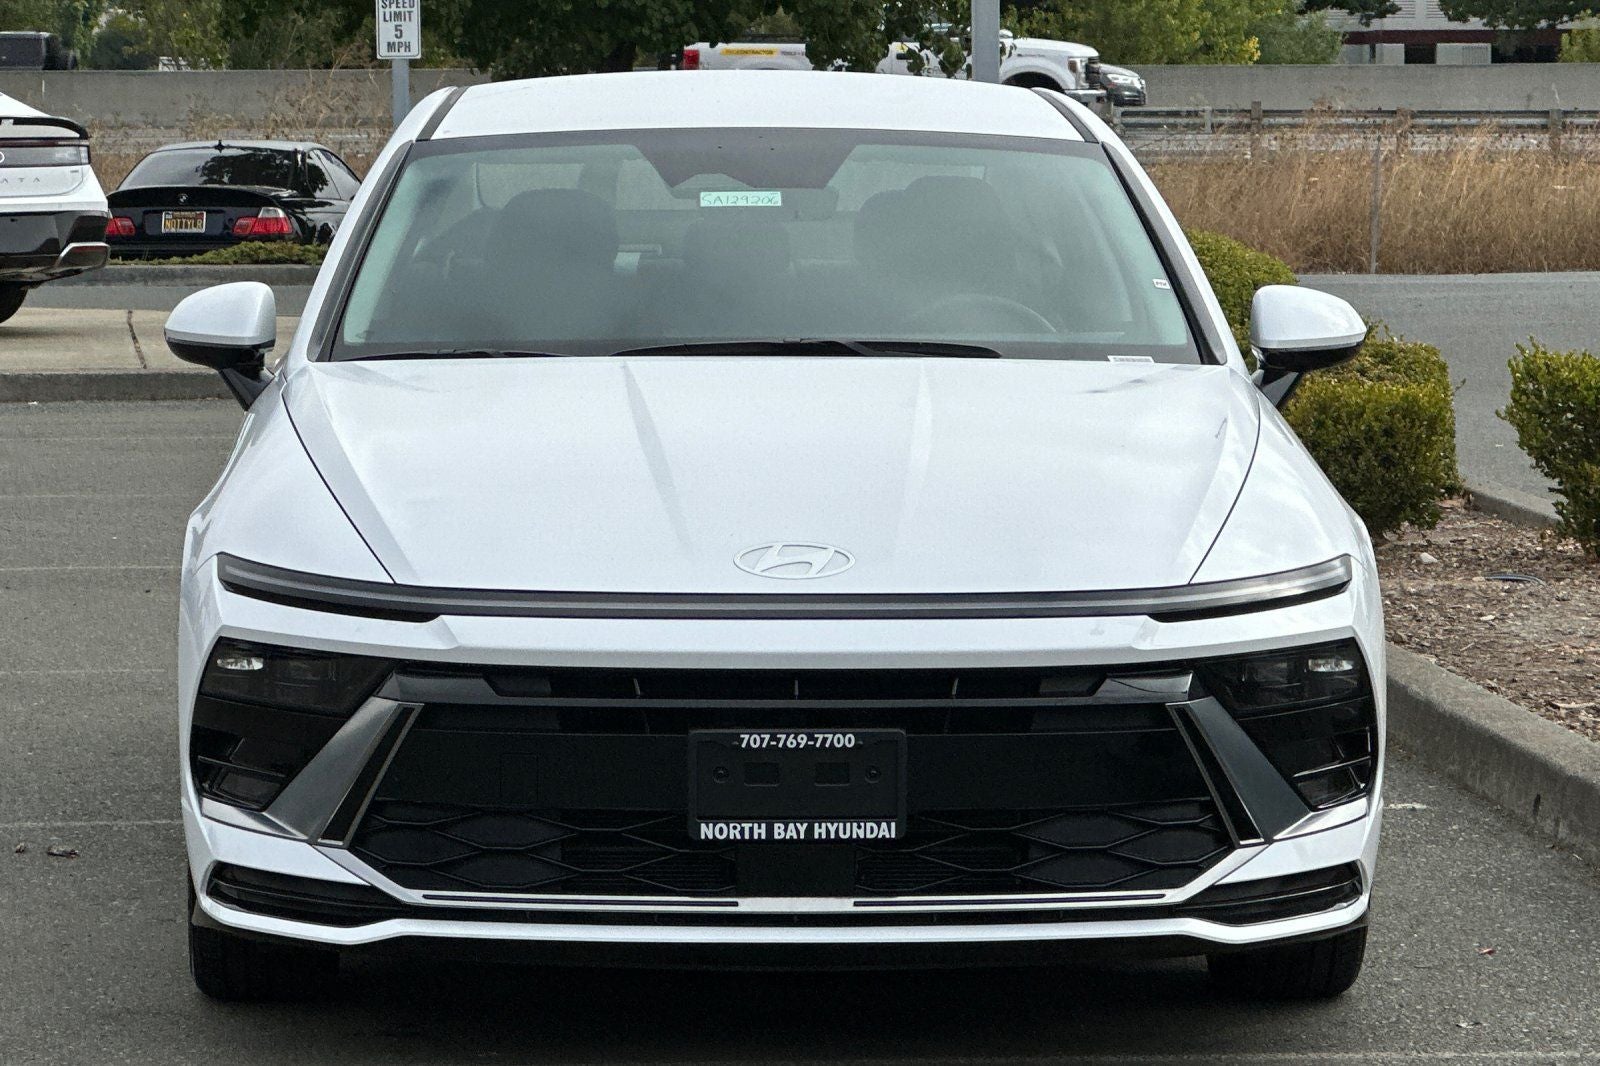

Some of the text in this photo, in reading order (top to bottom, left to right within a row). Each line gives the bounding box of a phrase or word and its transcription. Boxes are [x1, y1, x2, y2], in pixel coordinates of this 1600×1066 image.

[381, 0, 415, 9] SPEED
[383, 11, 414, 22] LIMIT
[394, 24, 403, 39] 5
[386, 41, 411, 53] MPH
[740, 734, 856, 749] 707-769-7700
[700, 821, 897, 840] NORTH BAY HYUNDAI
